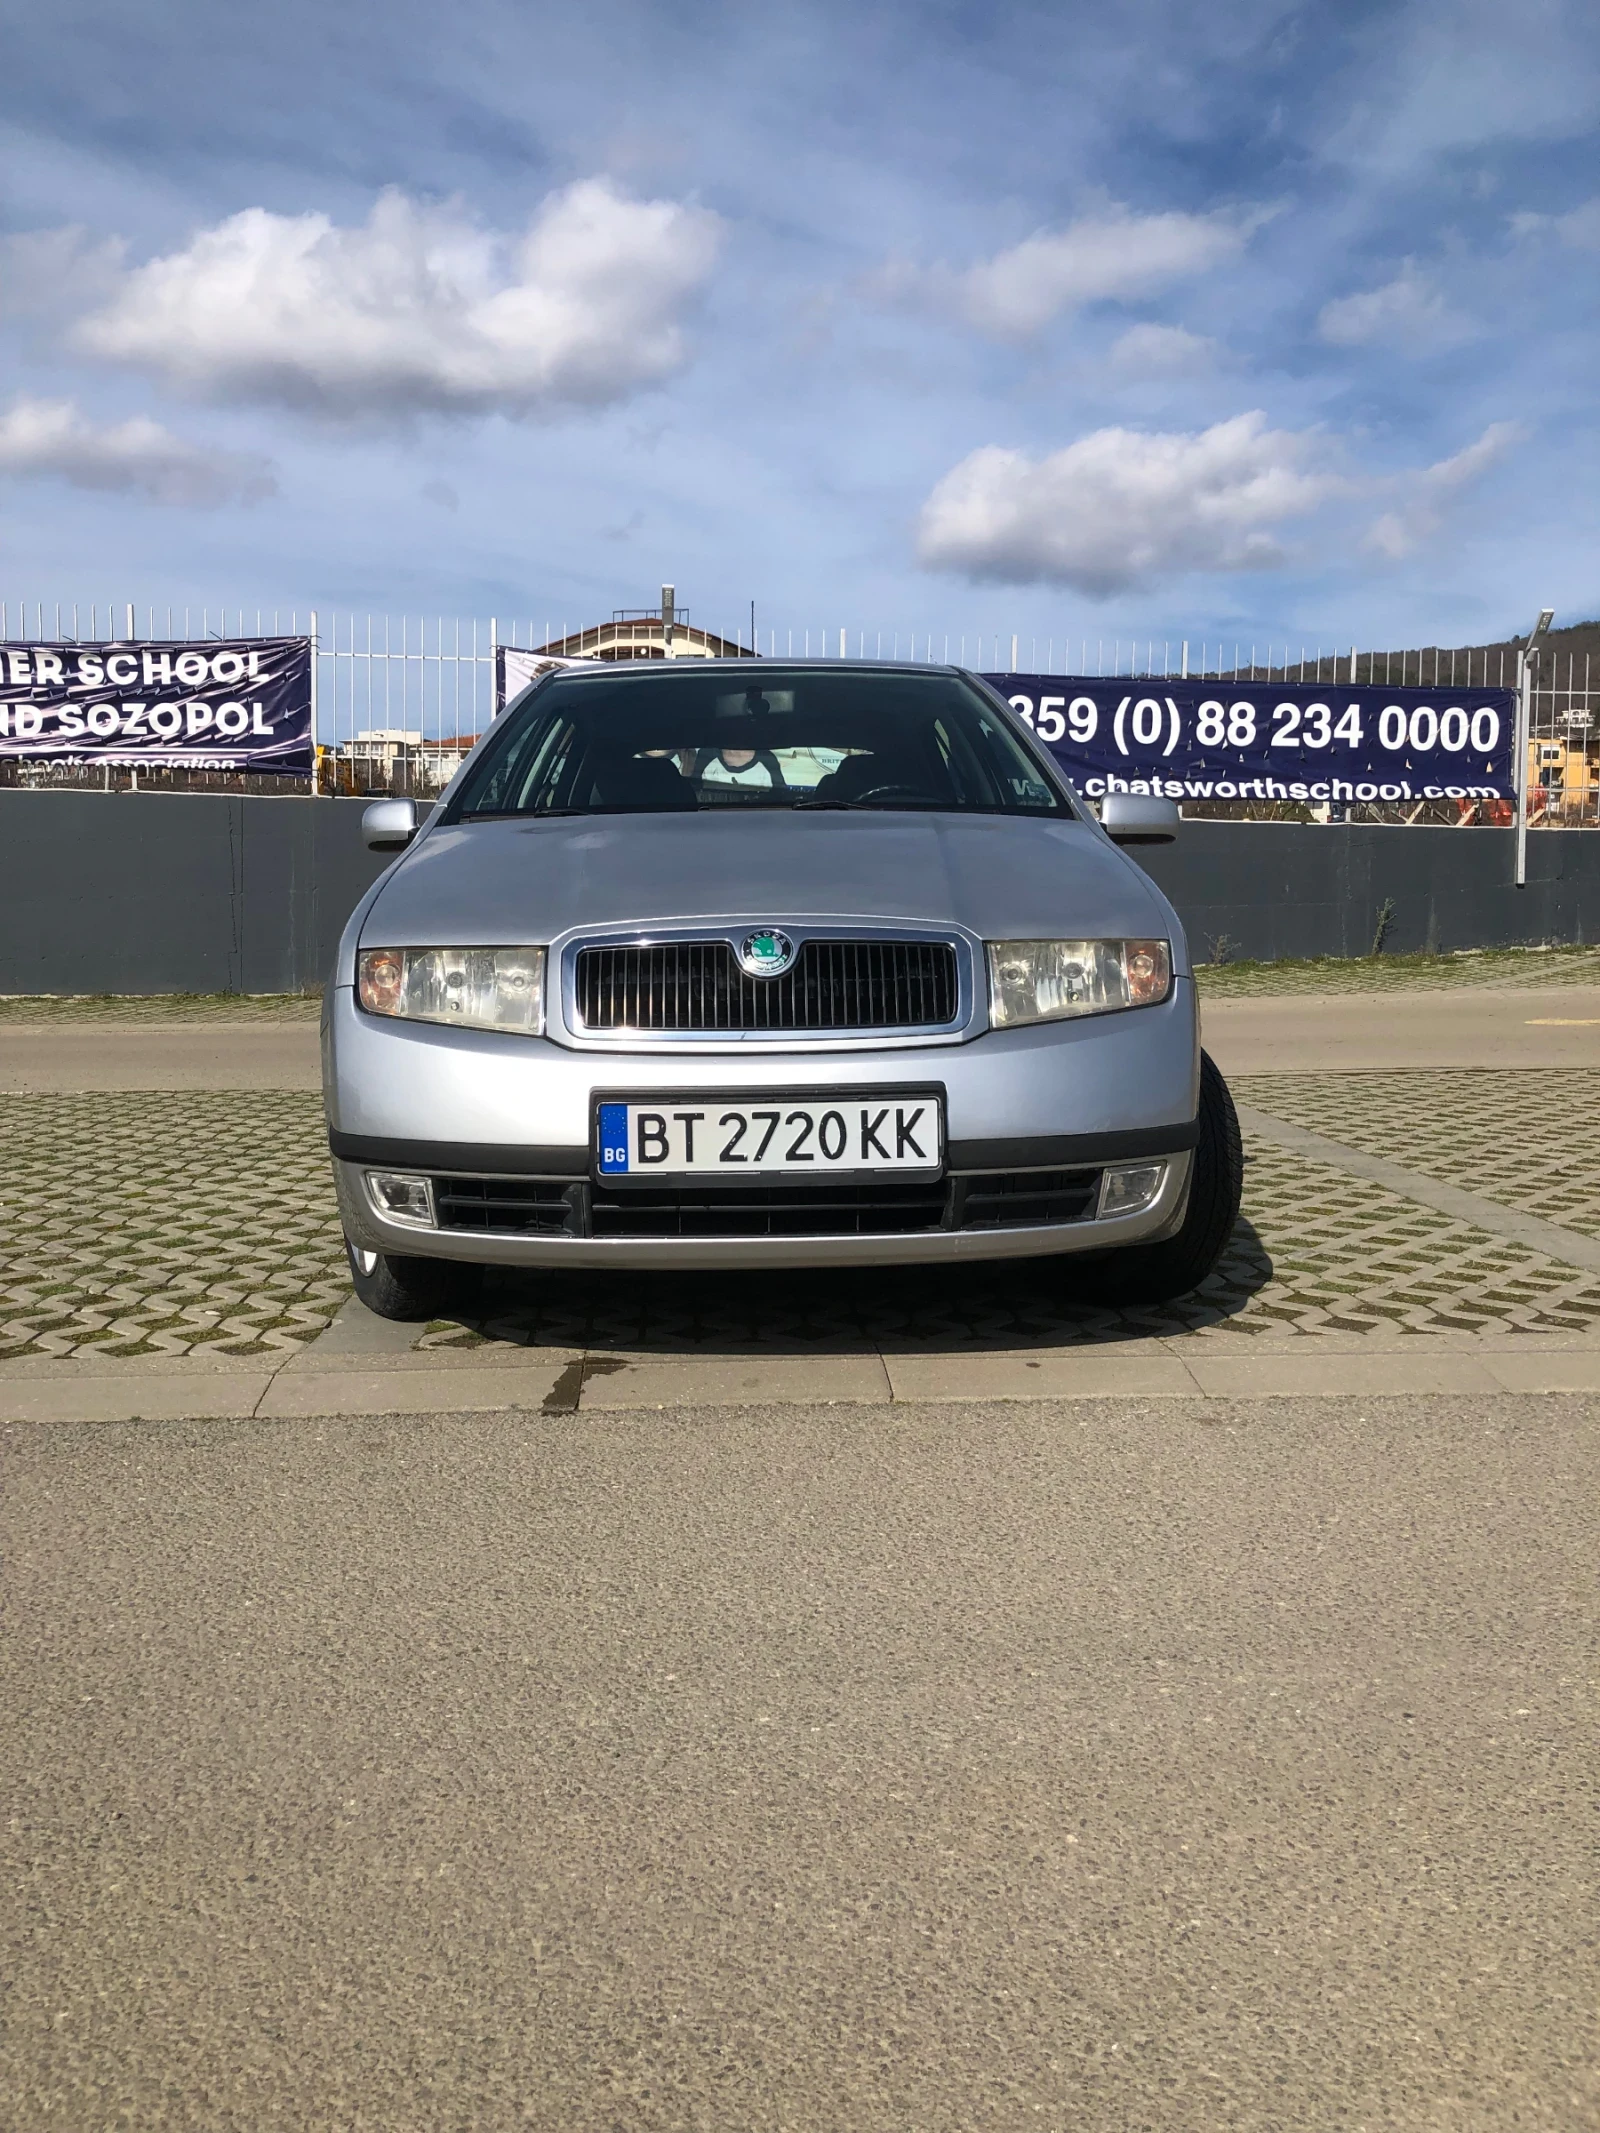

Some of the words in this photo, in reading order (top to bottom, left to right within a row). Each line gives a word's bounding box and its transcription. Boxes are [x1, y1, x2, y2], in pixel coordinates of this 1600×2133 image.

[0, 651, 65, 685] ER
[77, 650, 269, 687] SCHOOL
[58, 702, 274, 738] SOZOPOL
[1113, 696, 1181, 757] (0)
[1196, 700, 1257, 747] 88
[1271, 702, 1364, 749] 234
[1378, 705, 1500, 752] 0000
[604, 1147, 626, 1163] BG
[637, 1112, 705, 1164] BT
[719, 1109, 847, 1162] 2720
[860, 1107, 927, 1160] KK
